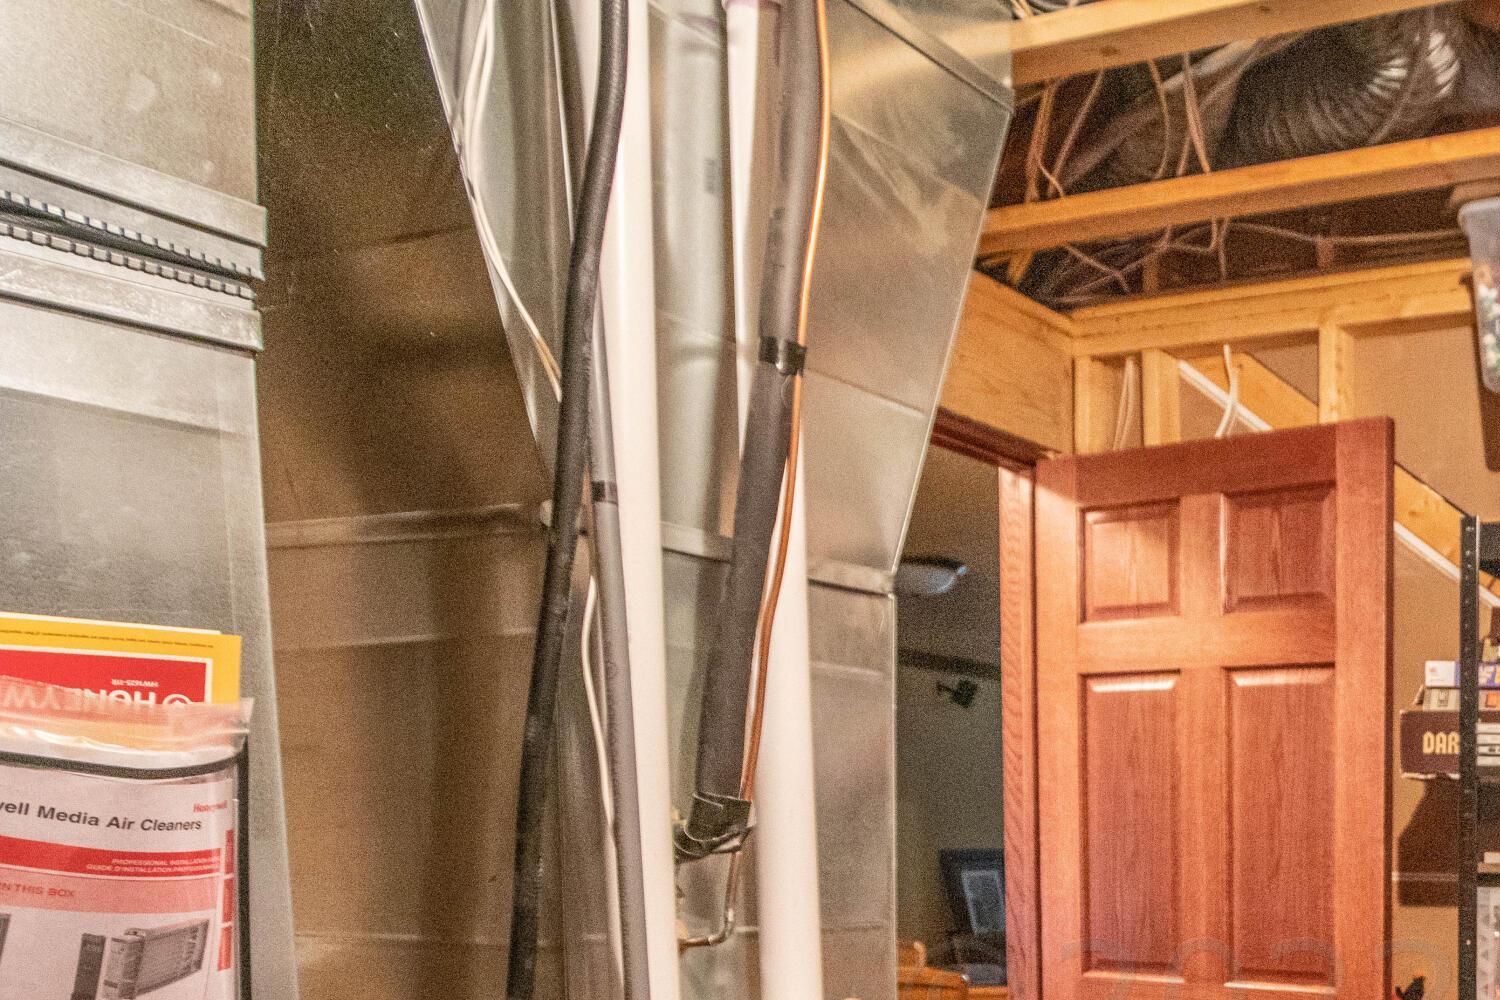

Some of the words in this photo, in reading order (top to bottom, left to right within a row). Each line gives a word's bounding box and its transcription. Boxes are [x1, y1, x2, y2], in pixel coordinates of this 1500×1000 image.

[37, 805, 100, 826] Media
[106, 816, 136, 831] Air
[140, 819, 202, 831] Cleaners
[15, 884, 43, 895] THIS
[48, 887, 75, 898] BOX
